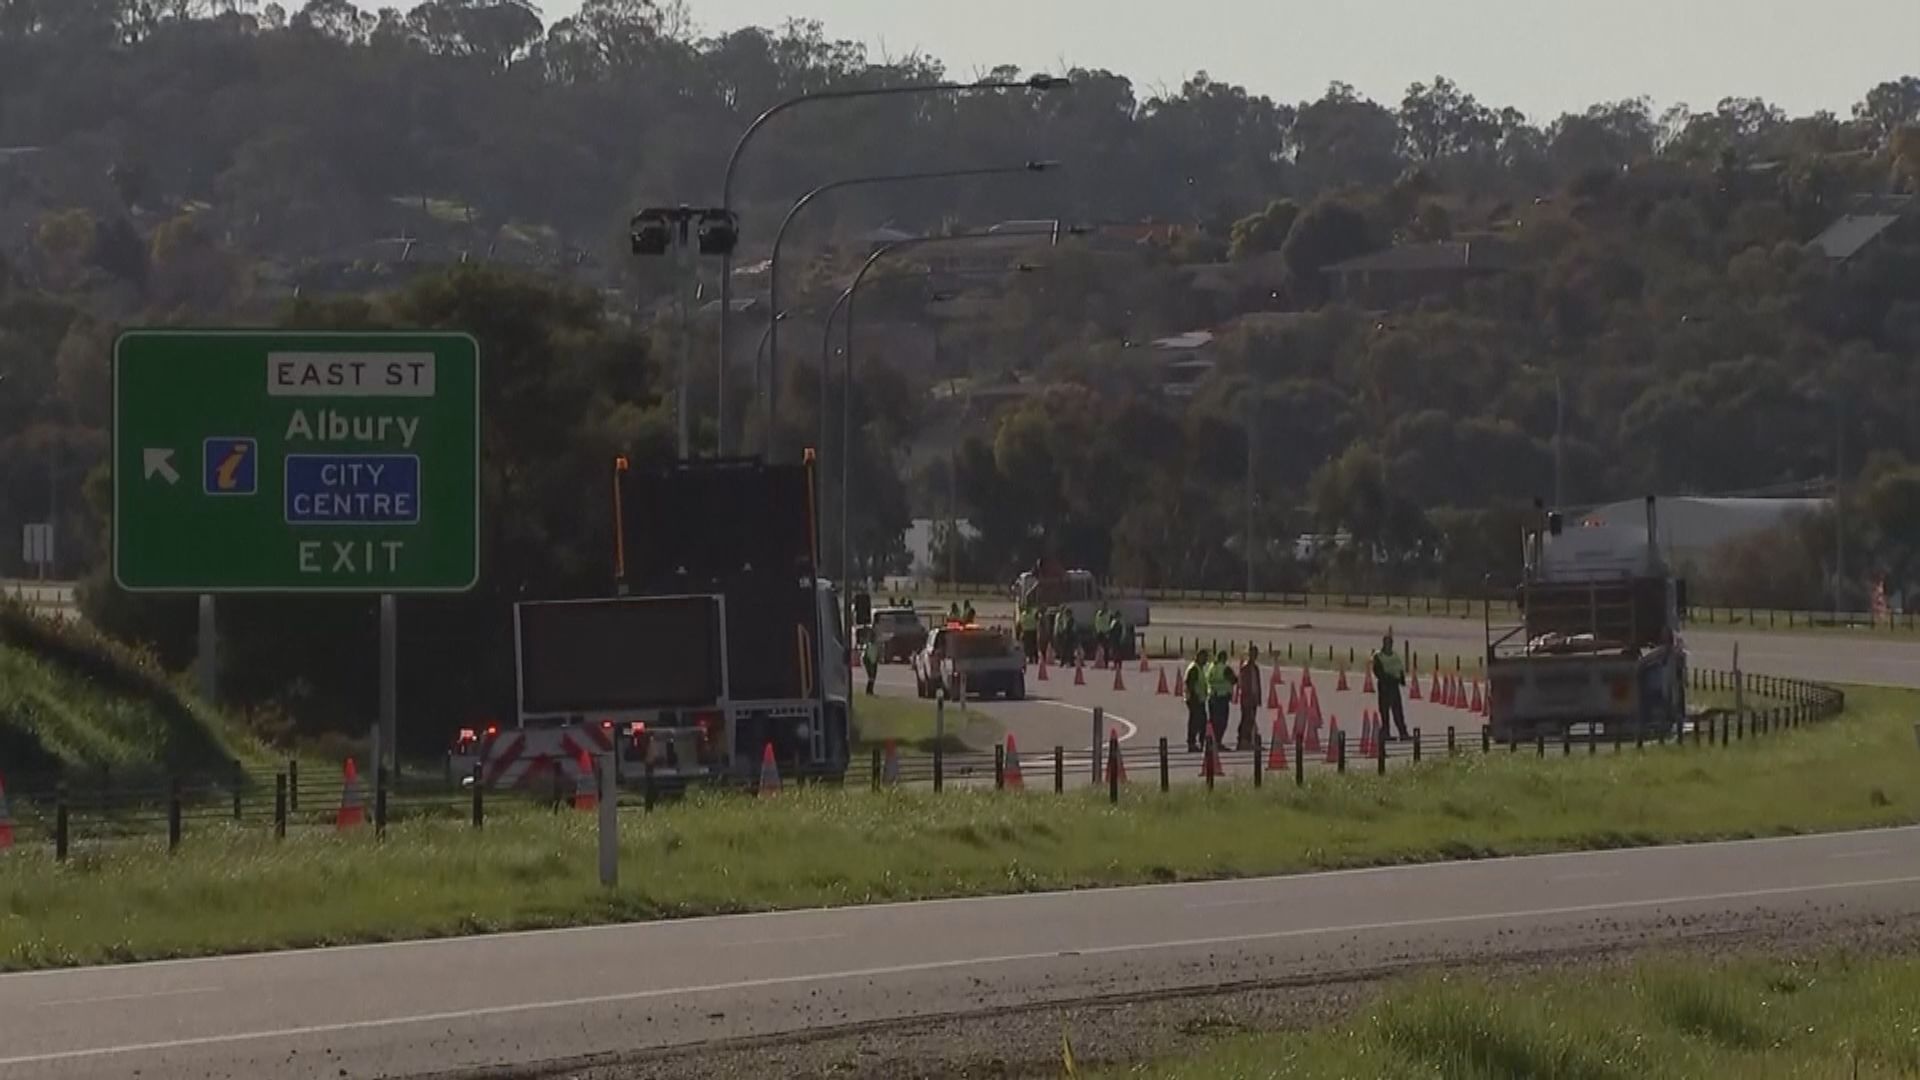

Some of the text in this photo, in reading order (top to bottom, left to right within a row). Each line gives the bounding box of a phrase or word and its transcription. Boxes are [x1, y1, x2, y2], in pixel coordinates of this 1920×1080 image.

[277, 363, 425, 386] EAST ST
[285, 409, 419, 447] Albury
[320, 464, 385, 486] CITY
[293, 494, 411, 516] CENTRE
[299, 541, 404, 572] EXIT
